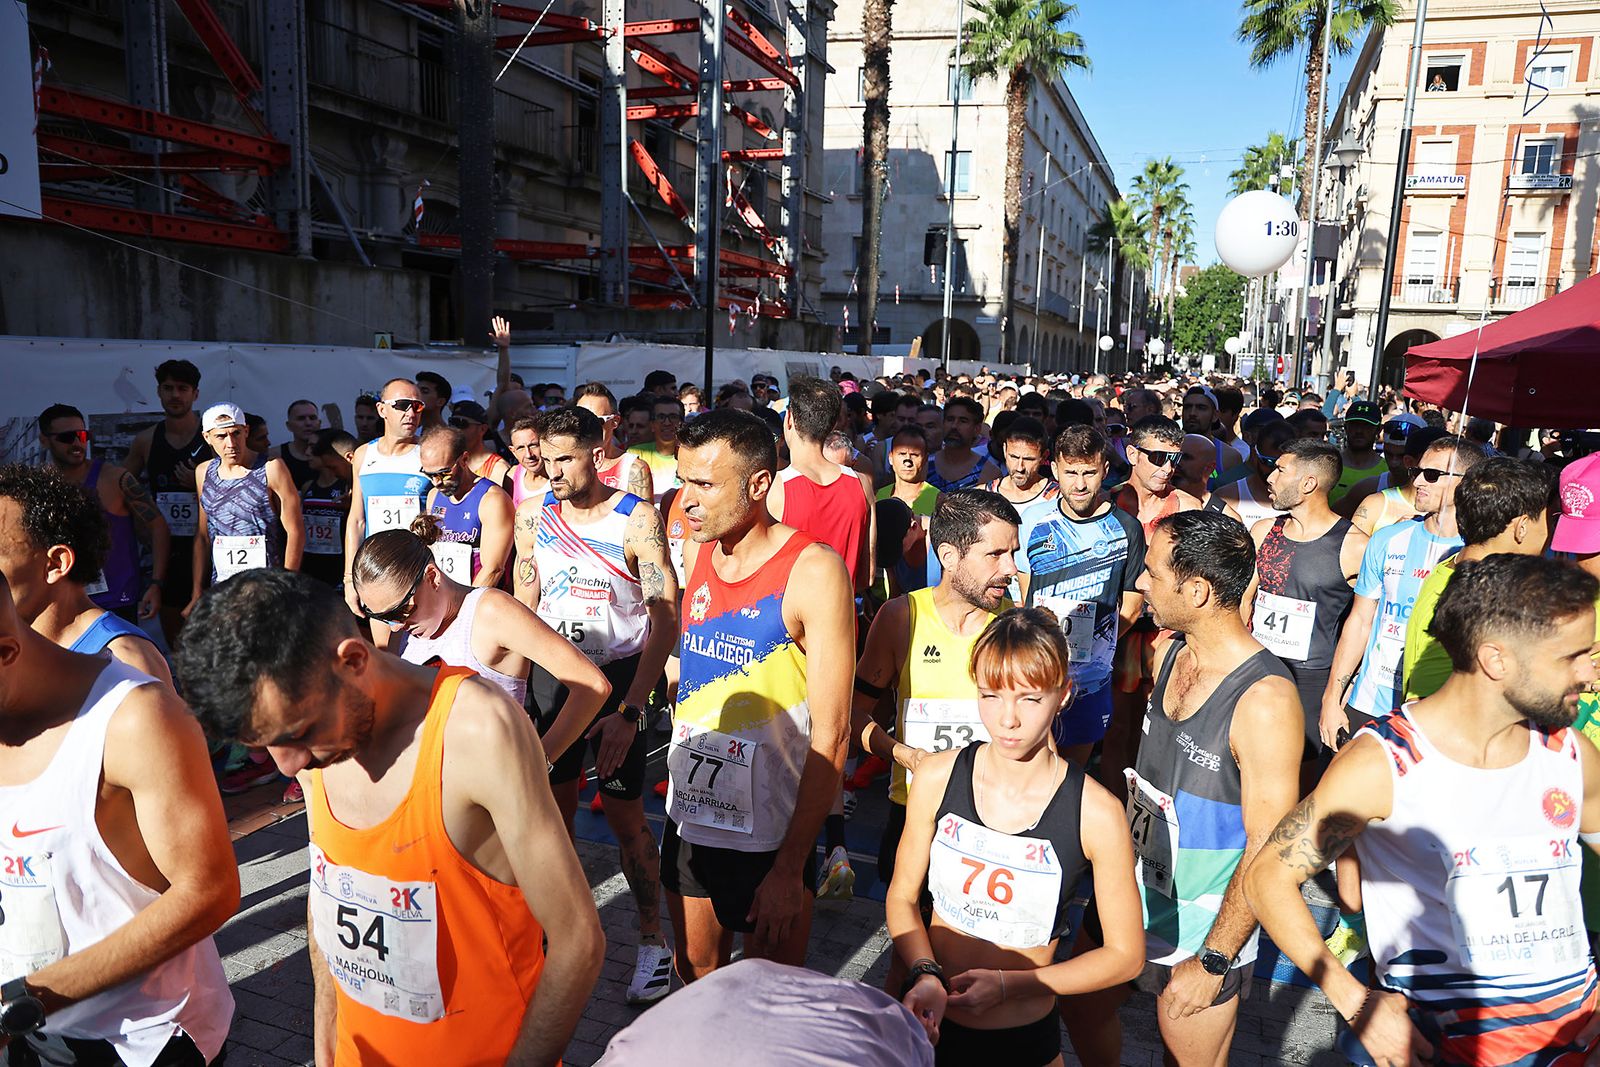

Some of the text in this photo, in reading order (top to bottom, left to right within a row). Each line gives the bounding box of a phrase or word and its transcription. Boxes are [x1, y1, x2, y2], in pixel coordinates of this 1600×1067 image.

[1264, 220, 1297, 236] 1:30
[170, 504, 191, 519] 65
[383, 509, 401, 524] 31
[308, 527, 332, 539] 192
[227, 550, 248, 565] 12
[440, 557, 454, 573] 13
[1055, 567, 1113, 596] ONUBENSE
[556, 620, 586, 643] 45
[1264, 611, 1289, 634] 41
[683, 631, 754, 666] PALACIEGO
[727, 740, 748, 759] 21K
[933, 725, 974, 753] 53
[688, 752, 724, 789] 77
[698, 796, 738, 812] ARRIAZA
[944, 818, 963, 842] 21K
[1130, 805, 1151, 846] 71
[1025, 843, 1051, 865] 21K
[1454, 847, 1480, 866] 21K
[1550, 838, 1572, 859] 21K
[4, 855, 35, 877] 21K
[961, 857, 1015, 905] 76
[355, 893, 378, 905] HUELVA
[390, 887, 422, 911] 21K
[1497, 874, 1549, 918] 17
[392, 908, 423, 919] HUELVA
[937, 890, 975, 929] Huelva
[963, 902, 1000, 921] ZUEVA
[337, 904, 389, 962] 54
[1514, 932, 1531, 944] DE
[1532, 930, 1548, 942] LA
[335, 955, 395, 987] MARHOUM
